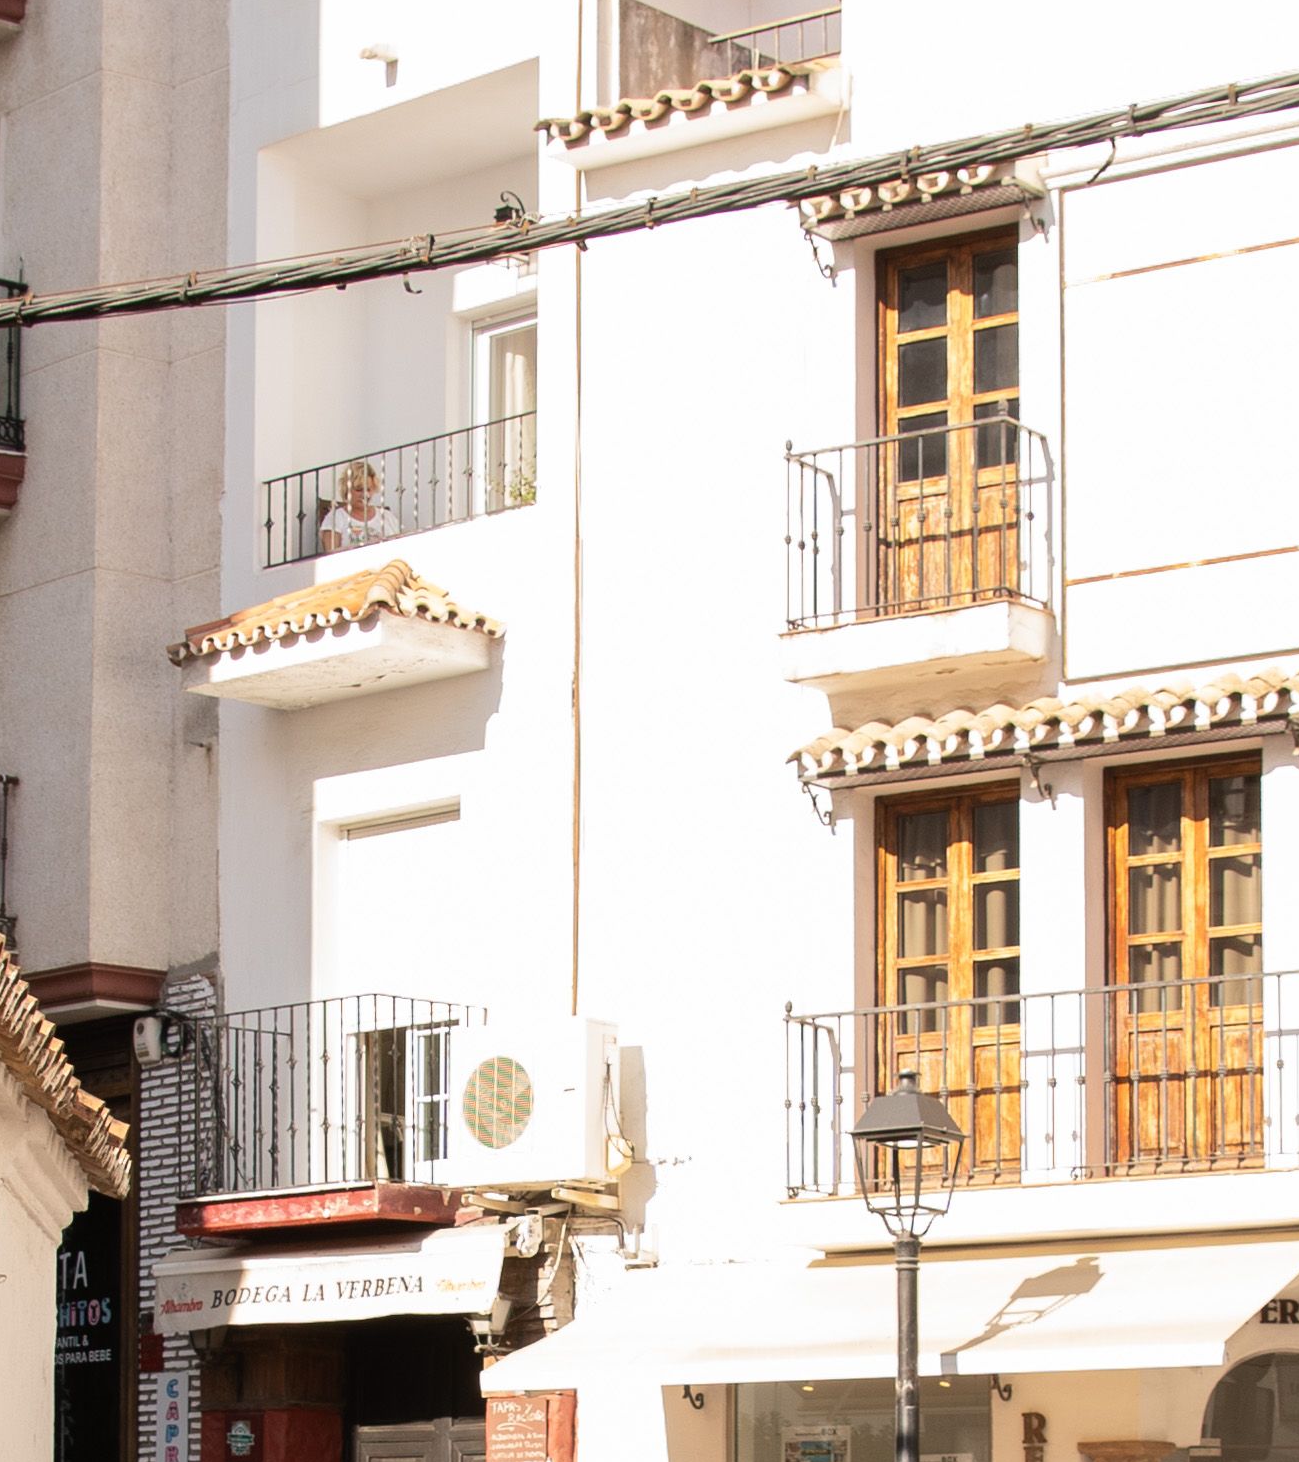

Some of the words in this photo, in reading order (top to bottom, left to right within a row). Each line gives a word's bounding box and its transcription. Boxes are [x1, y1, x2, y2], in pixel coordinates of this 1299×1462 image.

[211, 1287, 292, 1309] BODEGA
[302, 1283, 326, 1302] LA
[337, 1276, 423, 1299] VERBENA
[57, 1336, 81, 1348] ANTIL
[65, 1351, 88, 1363] PARA
[88, 1348, 112, 1361] BEBE
